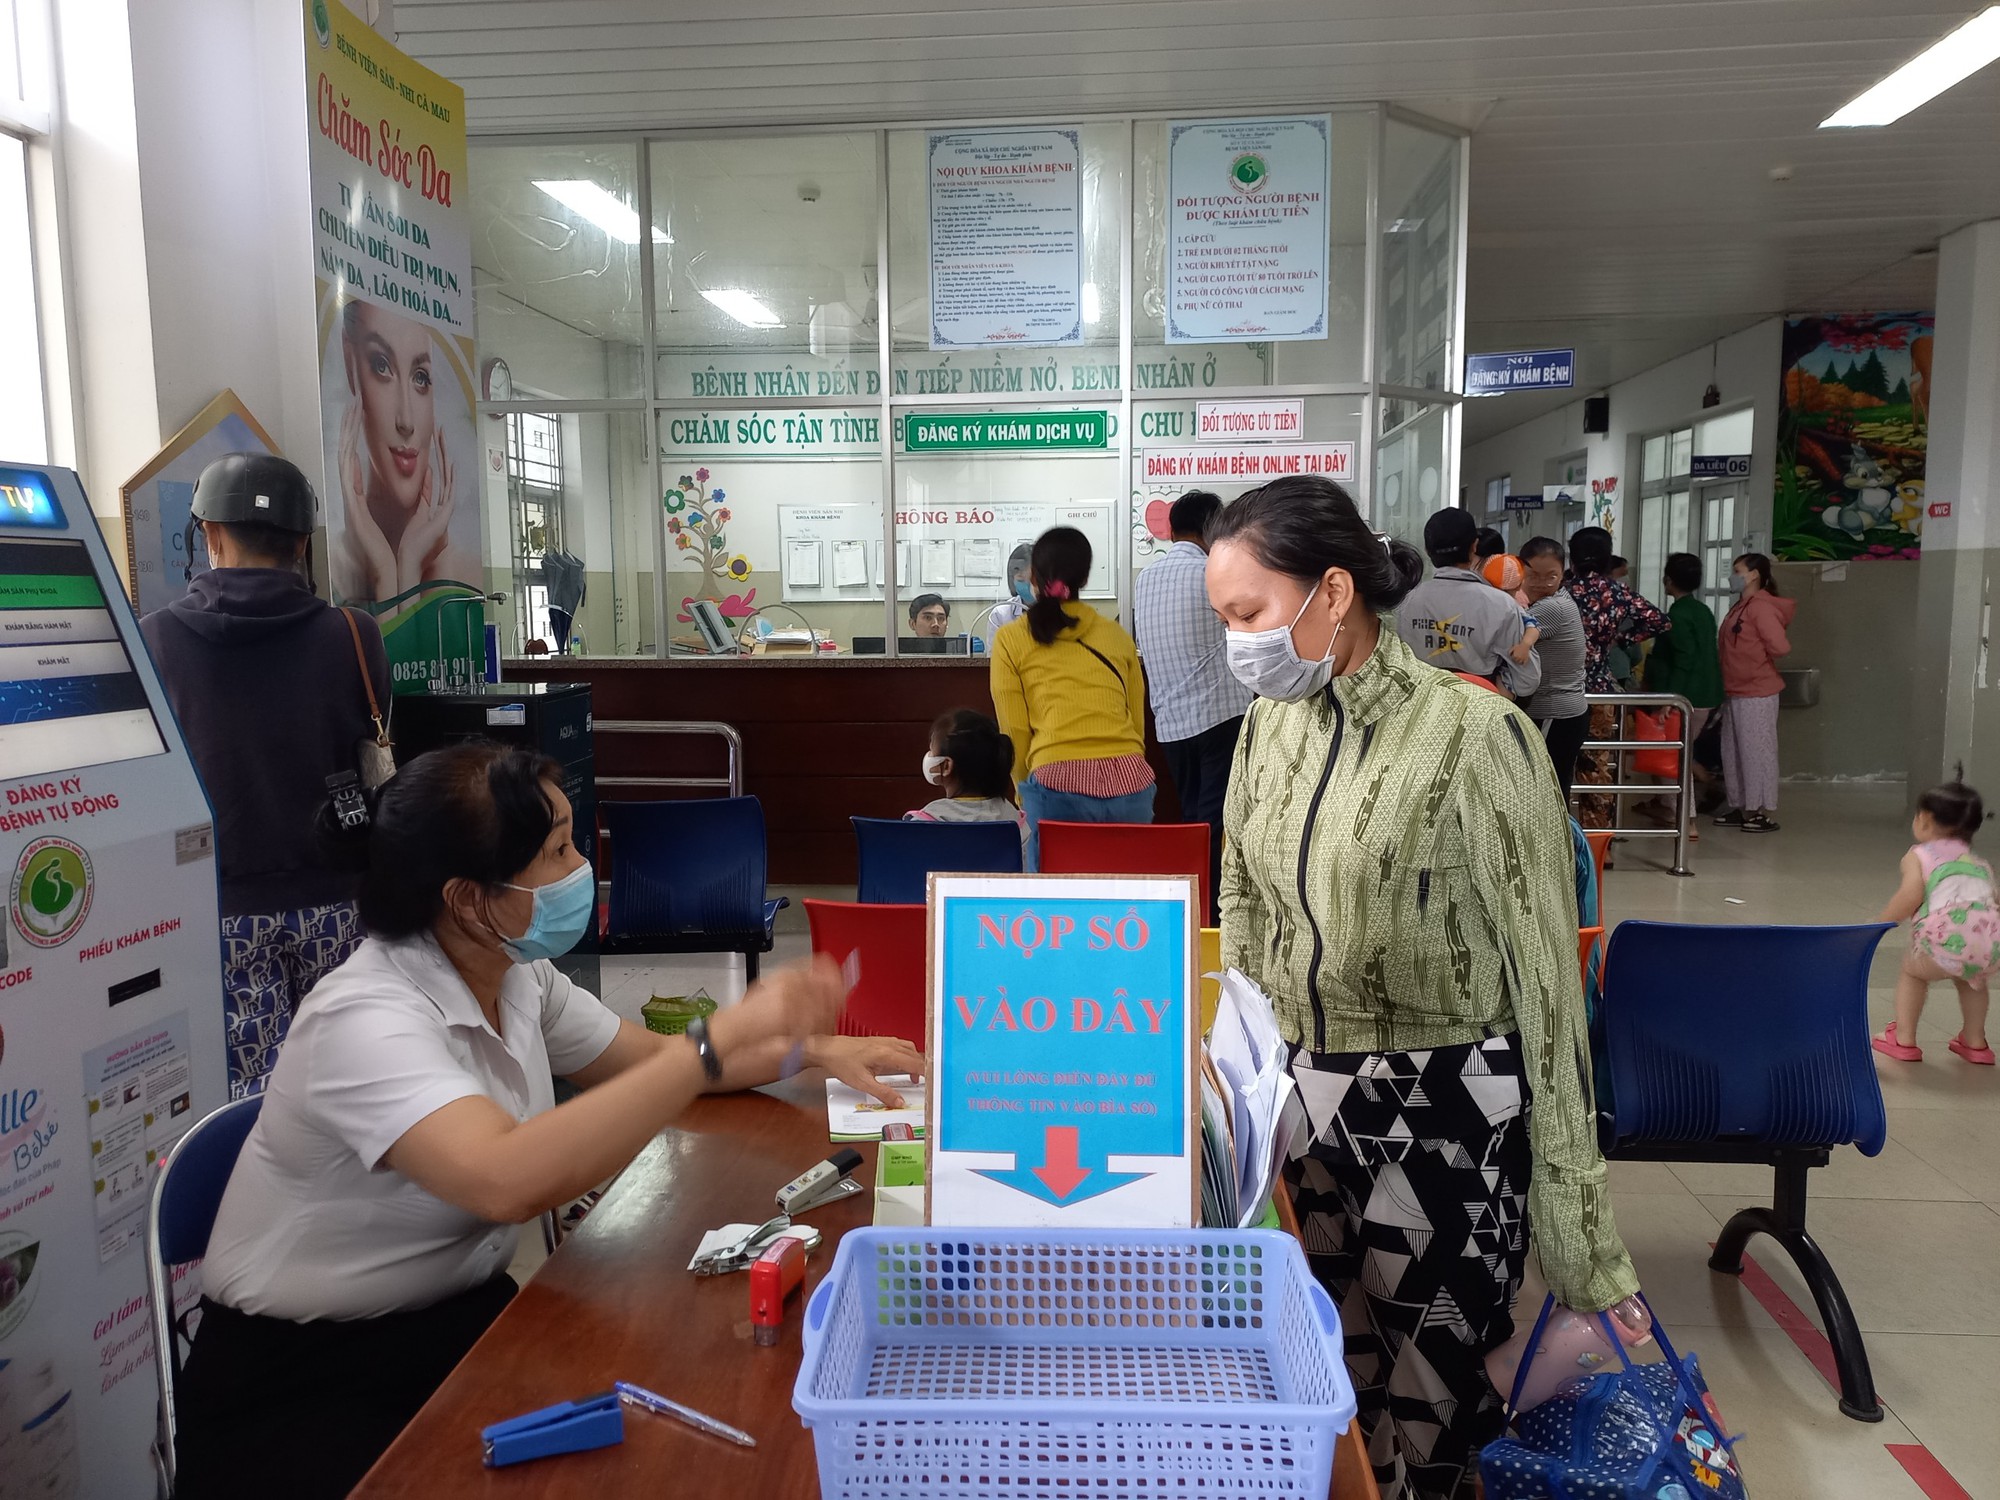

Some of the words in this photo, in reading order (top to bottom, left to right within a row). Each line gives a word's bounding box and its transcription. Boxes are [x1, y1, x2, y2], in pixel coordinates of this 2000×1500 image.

[358, 52, 379, 80] VIỆN
[399, 82, 416, 106] NHI
[416, 93, 430, 113] CÀ
[430, 101, 451, 124] MAU
[318, 72, 373, 167] Chăm
[378, 119, 413, 189] Sóc
[418, 143, 452, 208] Da
[936, 166, 955, 179] NỘI
[957, 166, 979, 177] QUY
[980, 165, 1010, 176] KHOA
[1011, 161, 1043, 175] KHÁM
[1045, 162, 1073, 175] BỆNH
[1245, 192, 1285, 204] NGƯỜI
[1288, 191, 1320, 205] BỆNH
[1223, 206, 1259, 219] KHÁM
[1262, 207, 1280, 218] ƯU
[411, 223, 432, 251] DA
[1201, 248, 1212, 256] EM
[347, 261, 365, 291] DA
[373, 273, 399, 304] LÃO
[401, 252, 424, 286] TRỊ
[426, 263, 462, 298] MỤN,
[1210, 275, 1226, 283] CAO
[1225, 300, 1243, 309] THAI
[754, 363, 811, 397] NHÂN
[817, 358, 860, 397] ĐẾN
[916, 356, 963, 394] TIẾP
[969, 351, 1023, 393] NIỀM
[1137, 354, 1196, 389] NHÂN
[1202, 350, 1218, 388] Ở
[1512, 364, 1541, 384] KHÁM
[1542, 362, 1569, 385] BỆNH
[670, 411, 731, 444] CHĂM
[737, 411, 777, 444] SÓC
[783, 411, 823, 450] TẬN
[829, 410, 880, 443] TÌNH
[917, 422, 958, 442] ĐĂNG
[962, 420, 983, 442] KÝ
[988, 420, 1031, 441] KHÁM
[1036, 422, 1071, 444] DỊCH
[1075, 421, 1096, 443] VỤ
[1202, 406, 1220, 432] ĐỐI
[1222, 411, 1256, 436] TƯỢNG
[1258, 409, 1272, 431] ƯU
[1274, 408, 1298, 431] TIÊN
[1148, 454, 1177, 476] ĐĂNG
[1179, 452, 1194, 476] KÝ
[1197, 451, 1228, 475] KHÁM
[1231, 451, 1260, 478] BỆNH
[1263, 454, 1301, 474] ONLINE
[1324, 449, 1347, 473] ĐÂY
[1729, 460, 1748, 472] 06
[893, 508, 949, 524] HÔNG
[955, 507, 995, 524] BÁO
[1934, 504, 1949, 515] WC
[393, 660, 427, 682] 0825
[6, 783, 57, 805] ĐĂNG
[60, 774, 82, 796] KÝ
[0, 809, 46, 834] BỆNH
[47, 802, 69, 823] TỰ
[71, 794, 119, 817] ĐỘNG
[79, 939, 113, 963] PHIẾU
[116, 926, 151, 951] KHÁM
[153, 917, 182, 939] BỆNH
[976, 909, 1076, 960] NỘP
[0, 966, 32, 990] CODE
[953, 986, 1057, 1034] VÀO
[1071, 988, 1172, 1035] ĐÂY
[965, 1071, 1000, 1087] (VUI
[1003, 1069, 1050, 1086] LÒNG
[967, 1096, 1025, 1112] THÔNG
[1029, 1099, 1056, 1112] TIN
[1059, 1098, 1096, 1115] VÀO
[1098, 1099, 1127, 1115] BÌA
[13, 1121, 59, 1173] Bébé
[94, 1311, 115, 1341] Gel
